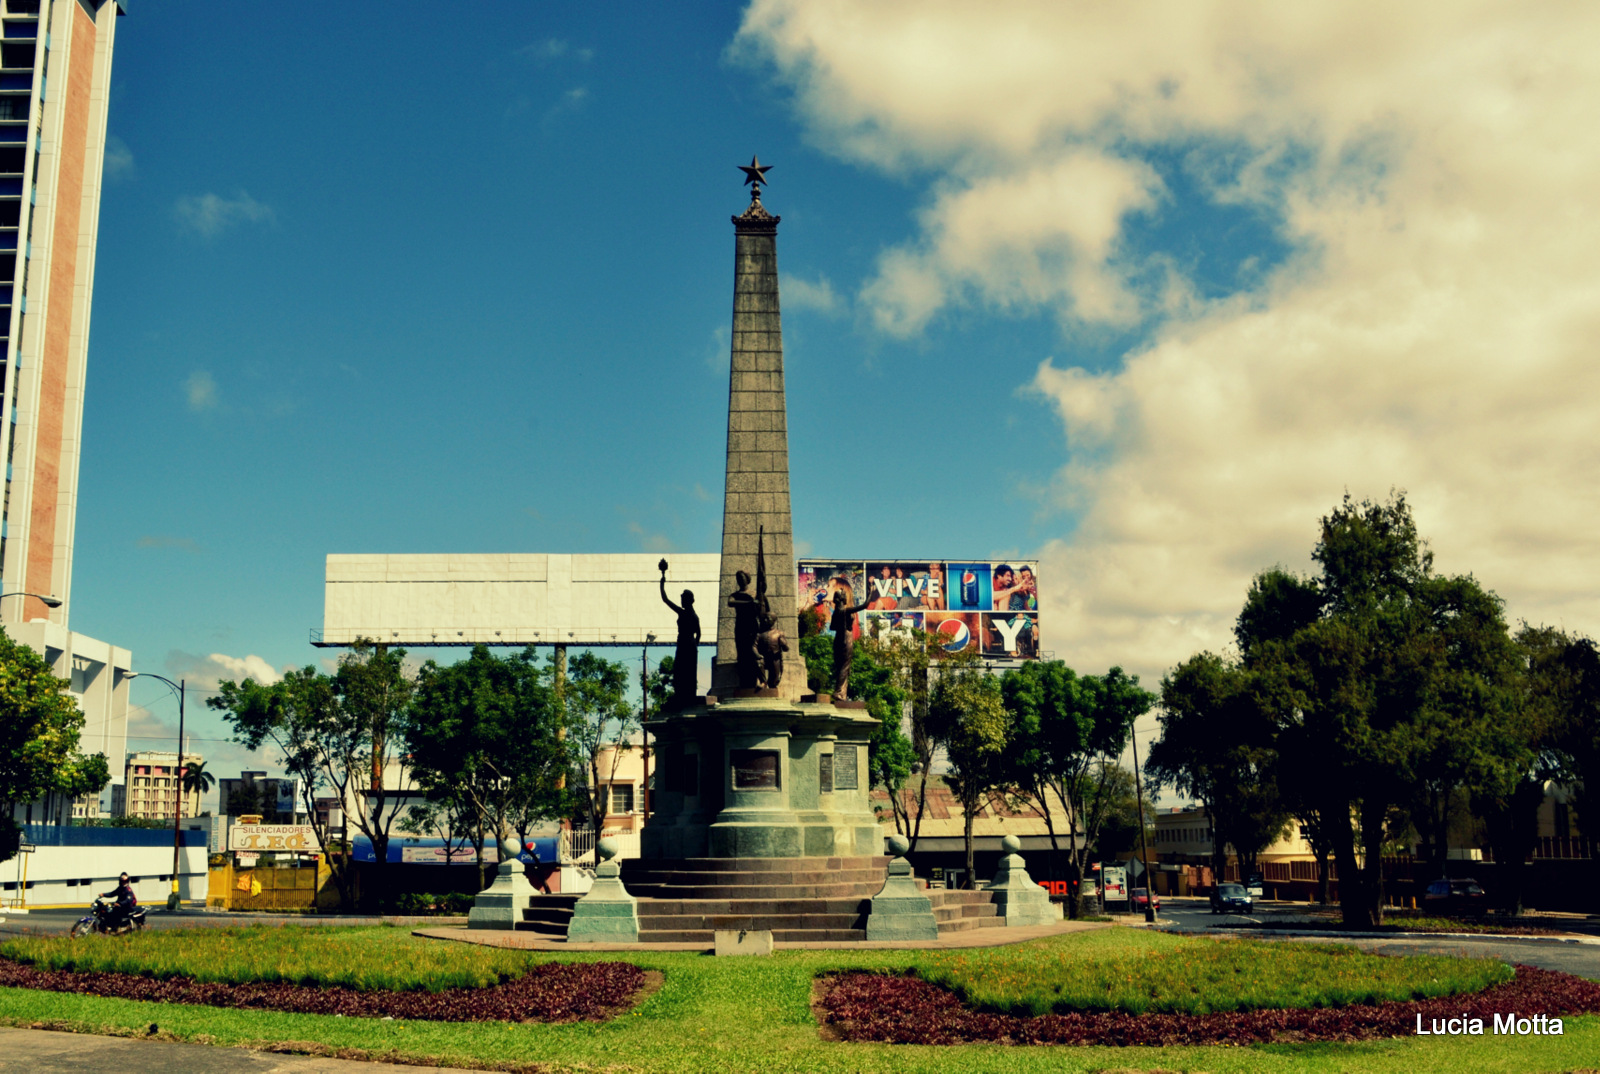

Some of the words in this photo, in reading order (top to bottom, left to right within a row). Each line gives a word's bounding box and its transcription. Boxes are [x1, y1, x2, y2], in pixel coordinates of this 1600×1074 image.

[873, 578, 940, 598] VIVE
[242, 826, 312, 834] SILENCIADORES
[248, 832, 307, 849] LEO
